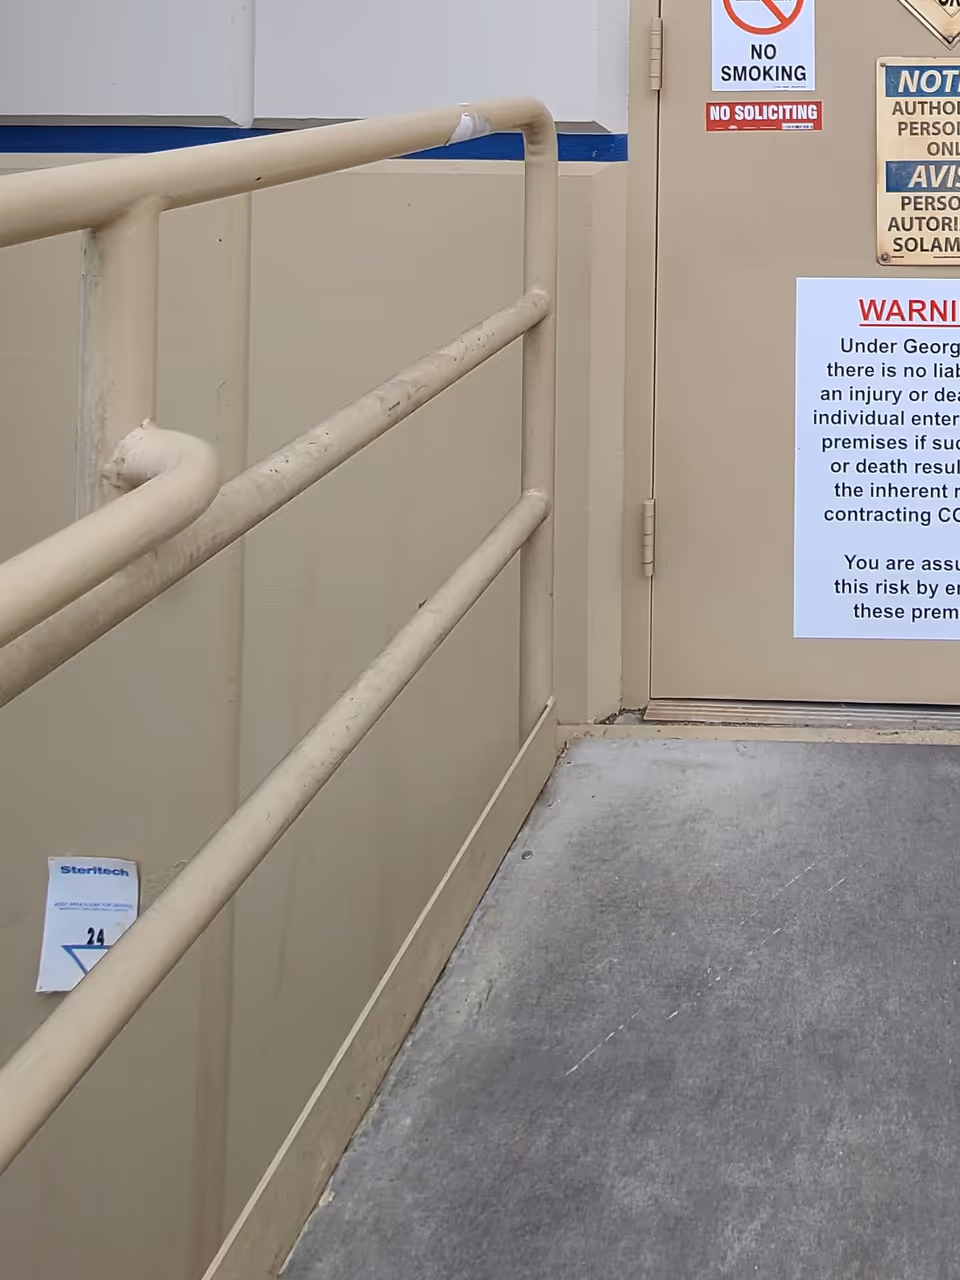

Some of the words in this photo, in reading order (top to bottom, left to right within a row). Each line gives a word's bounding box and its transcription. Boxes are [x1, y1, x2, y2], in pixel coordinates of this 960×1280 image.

[750, 43, 777, 60] NO
[720, 65, 807, 82] SMOKING
[709, 105, 731, 121] NO
[734, 104, 818, 120] SOLICITING
[840, 337, 898, 354] Under
[826, 361, 875, 378] there
[881, 362, 897, 378] is
[903, 366, 927, 378] no
[820, 389, 842, 401] an
[849, 385, 903, 406] injury
[908, 390, 929, 402] or
[813, 409, 905, 426] individual
[822, 433, 908, 453] premises
[915, 434, 927, 450] if
[830, 461, 851, 473] or
[855, 458, 908, 474] death
[834, 481, 864, 498] the
[870, 482, 949, 499] inherent
[824, 506, 931, 527] contracting
[843, 554, 879, 571] You
[885, 558, 915, 571] are
[834, 578, 869, 595] this
[875, 578, 910, 595] risk
[916, 579, 939, 600] by
[853, 602, 905, 619] these
[60, 865, 130, 877] Steritech
[86, 926, 106, 947] 24
